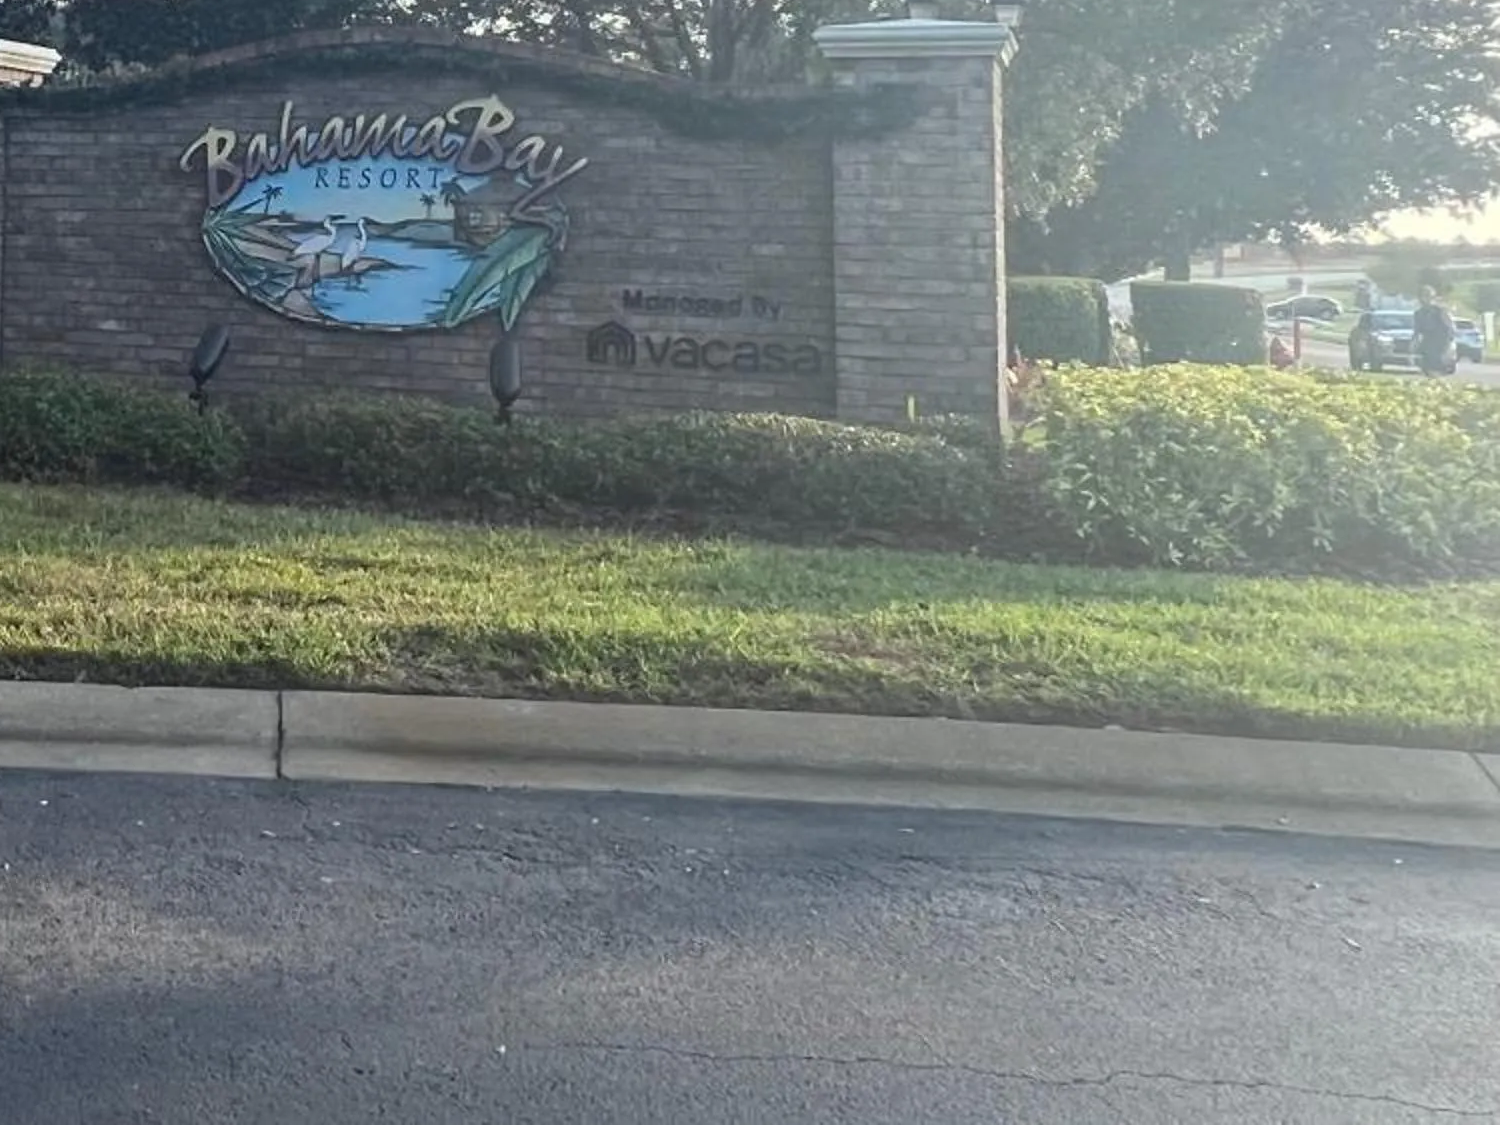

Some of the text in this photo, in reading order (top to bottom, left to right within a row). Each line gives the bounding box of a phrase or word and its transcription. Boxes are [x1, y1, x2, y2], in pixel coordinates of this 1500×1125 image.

[180, 93, 588, 251] Bahama Bay
[313, 166, 445, 191] RESORT
